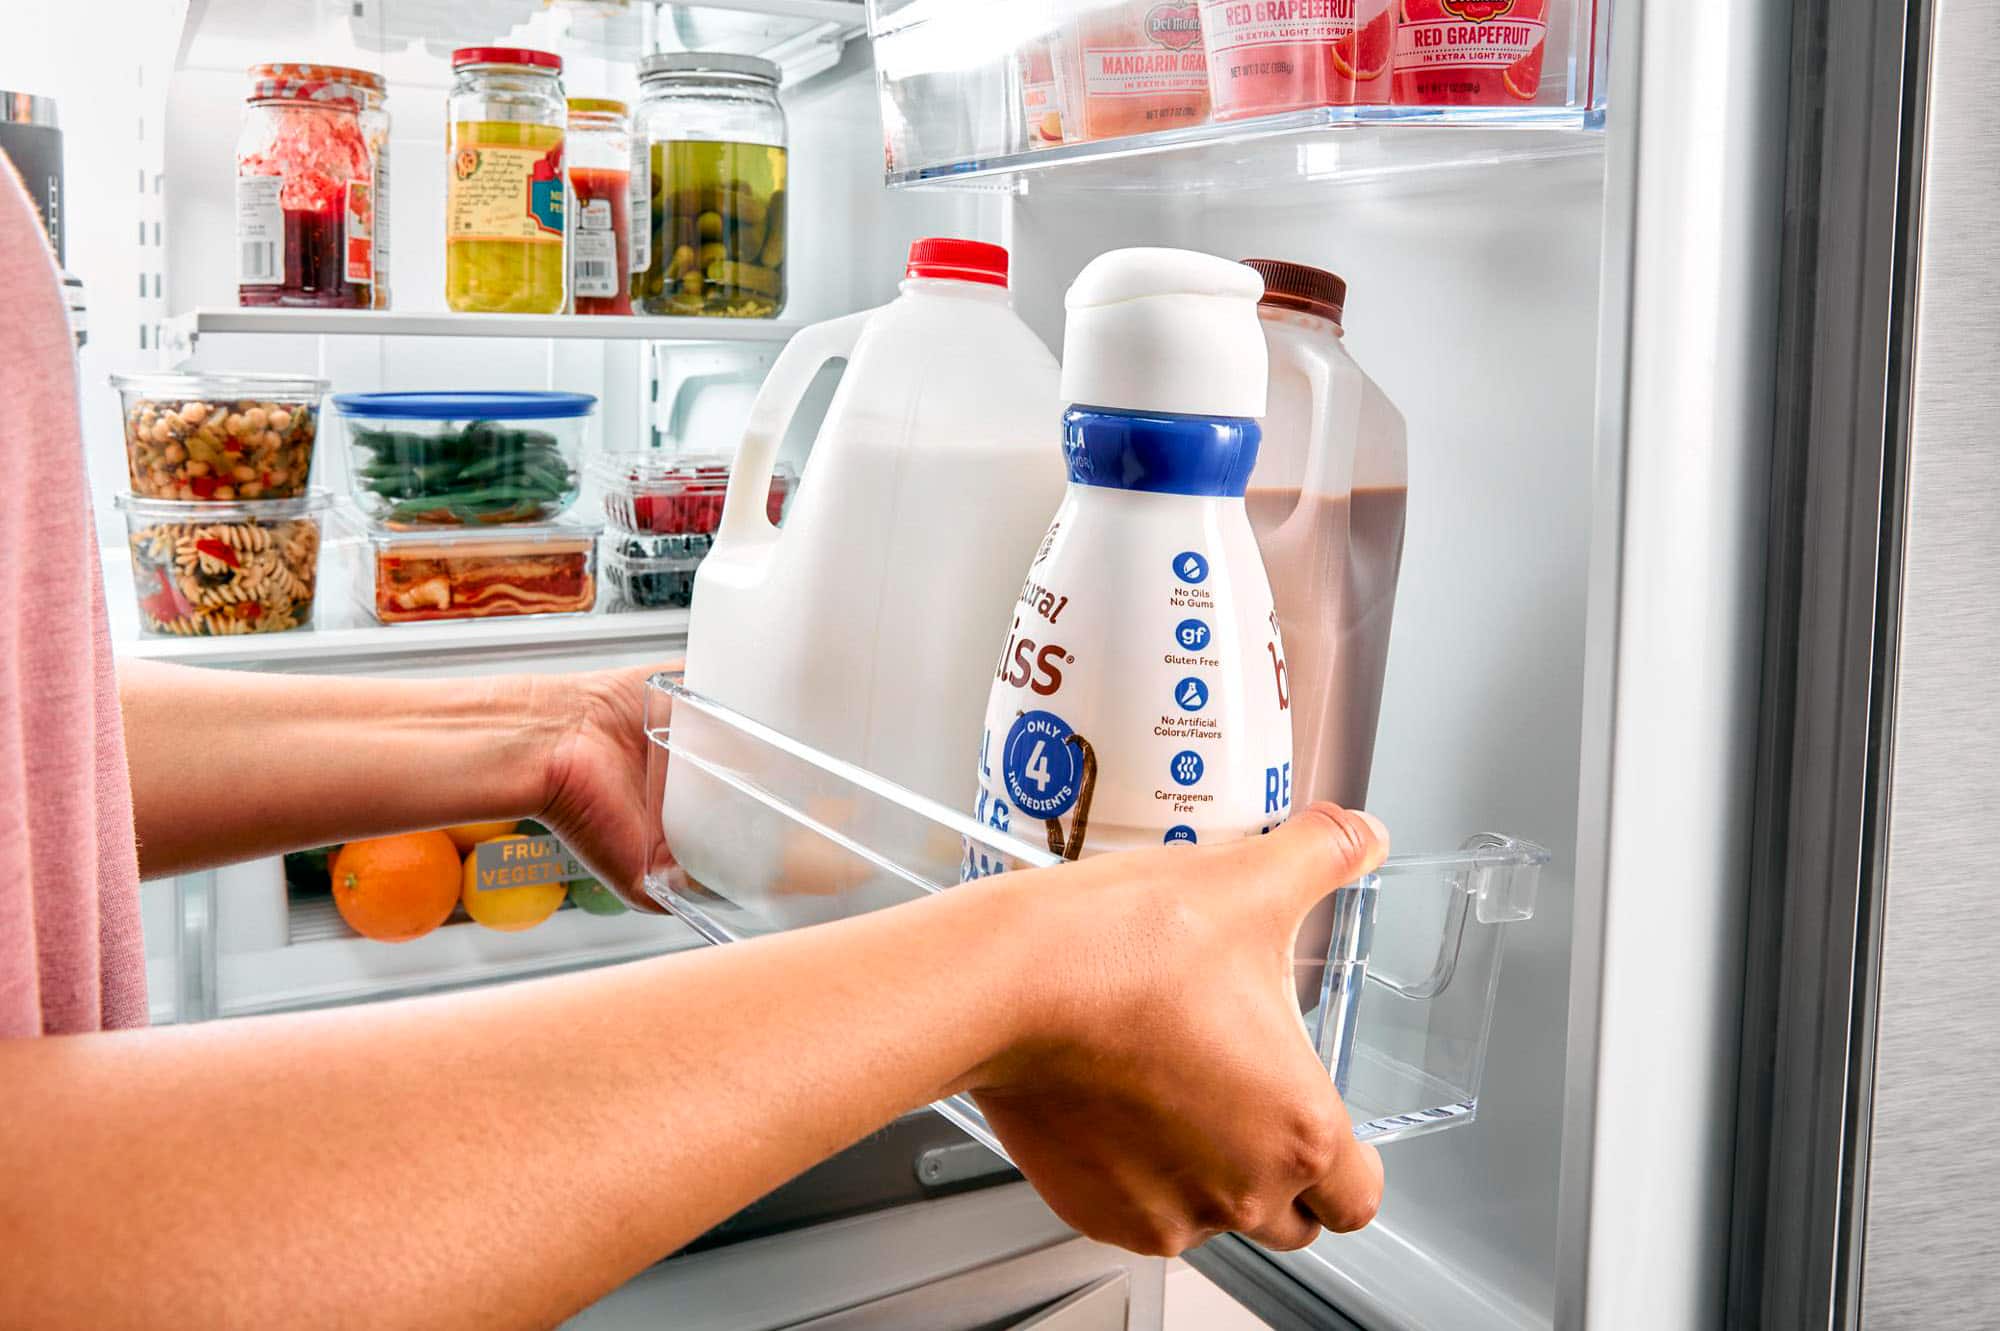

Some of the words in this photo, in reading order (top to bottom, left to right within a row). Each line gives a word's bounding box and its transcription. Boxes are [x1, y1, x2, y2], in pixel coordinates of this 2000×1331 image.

[1225, 4, 1251, 26] RED
[1247, 31, 1276, 40] EXTRA
[1280, 28, 1309, 37] LIGHT
[1414, 29, 1442, 47] RED
[1447, 26, 1531, 46] GRAPEFRUIT
[1102, 54, 1178, 74] MANDARIN
[1423, 54, 1432, 63] IN
[1436, 52, 1466, 62] EXTRA
[1469, 52, 1498, 60] LIGHT
[1174, 588, 1189, 597] No
[1191, 589, 1210, 598] Oils
[1170, 597, 1185, 607] No
[1187, 599, 1214, 608] Gums
[1182, 626, 1207, 645] gf
[1164, 654, 1197, 665] Gluten
[1200, 656, 1219, 667] Free
[1161, 716, 1175, 726] No
[1177, 717, 1217, 728] Artificial
[1027, 720, 1061, 738] ONLY
[1154, 726, 1222, 739] Colors/Flavors
[1025, 740, 1051, 792] 4
[1008, 771, 1073, 812] INGREDIENTS
[1155, 790, 1214, 803] Carrageenan
[1174, 803, 1194, 813] Free
[1175, 831, 1188, 839] no
